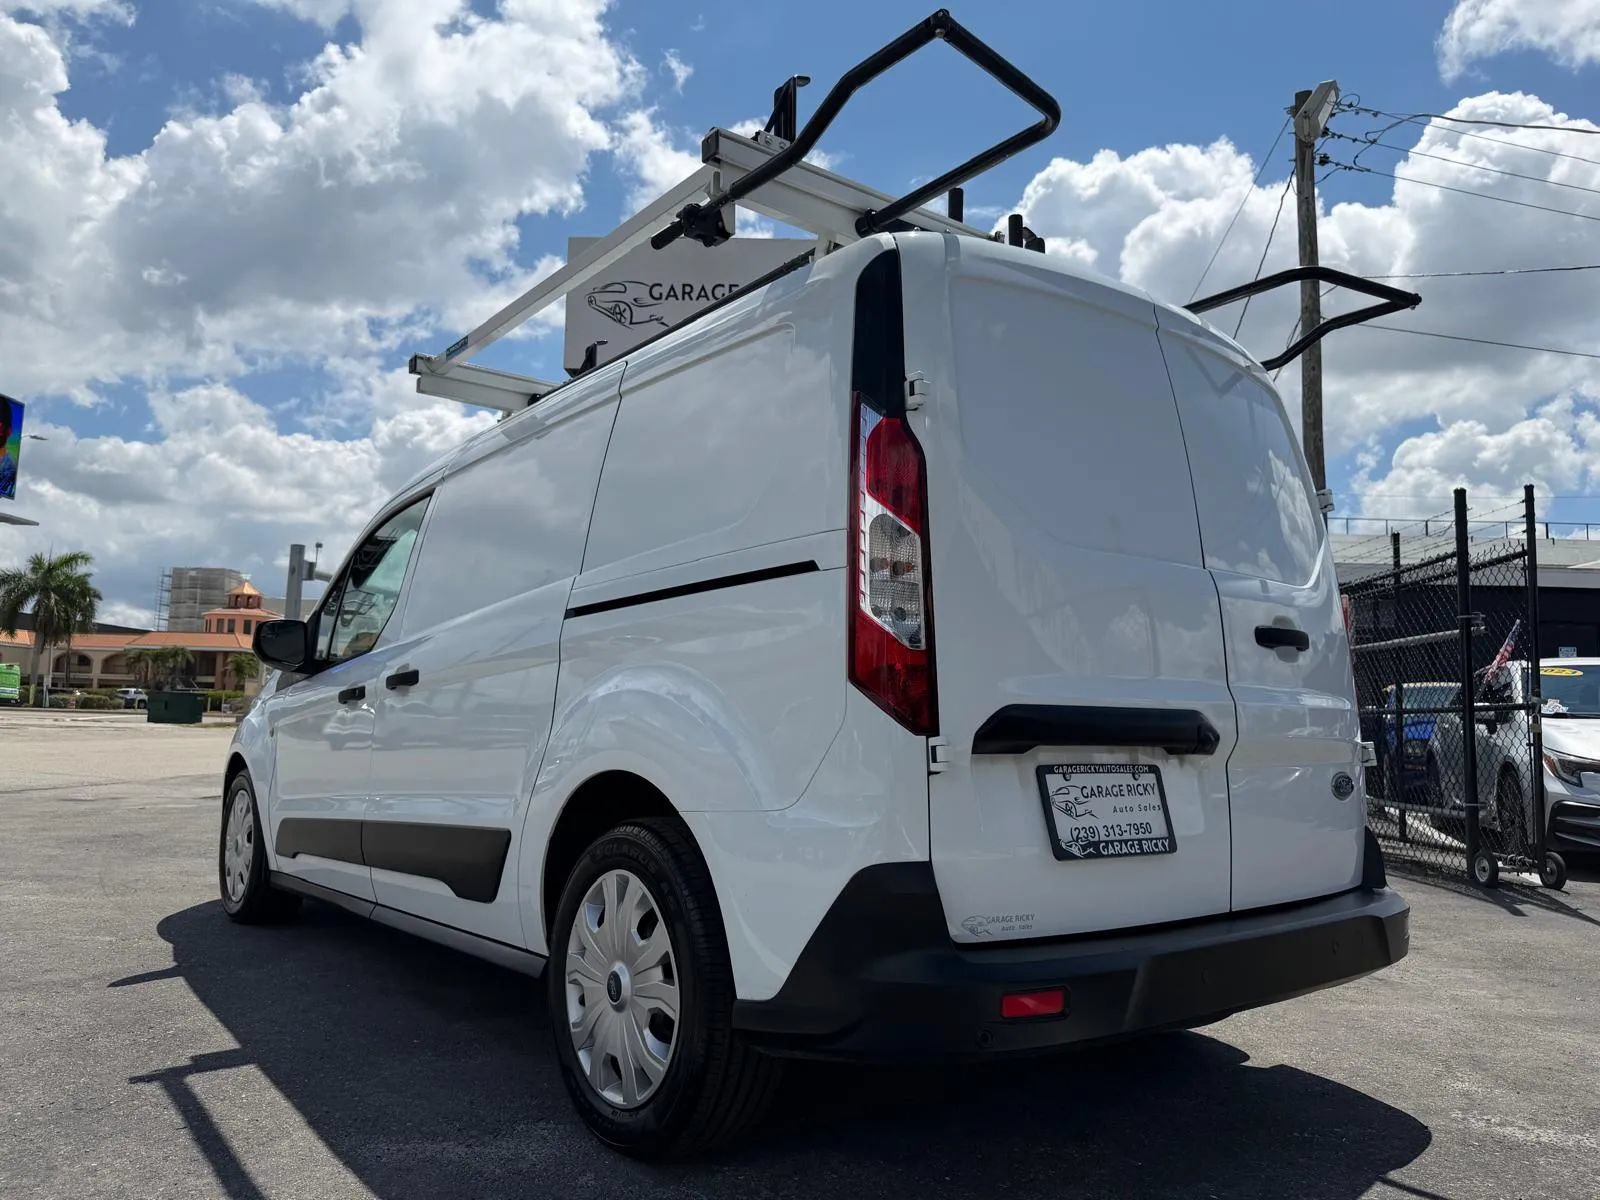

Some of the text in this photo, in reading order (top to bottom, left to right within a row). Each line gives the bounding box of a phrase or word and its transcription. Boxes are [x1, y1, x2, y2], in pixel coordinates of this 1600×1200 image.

[1053, 765, 1149, 774] GARAGERICKYAUTOSALES.COM
[1080, 783, 1156, 799] GARAGE RICKY
[1112, 803, 1161, 814] Auto Sales
[1070, 822, 1153, 841] (239) 313-7950
[1100, 839, 1170, 856] GARAGE RICKY
[986, 915, 1013, 924] GARAGE
